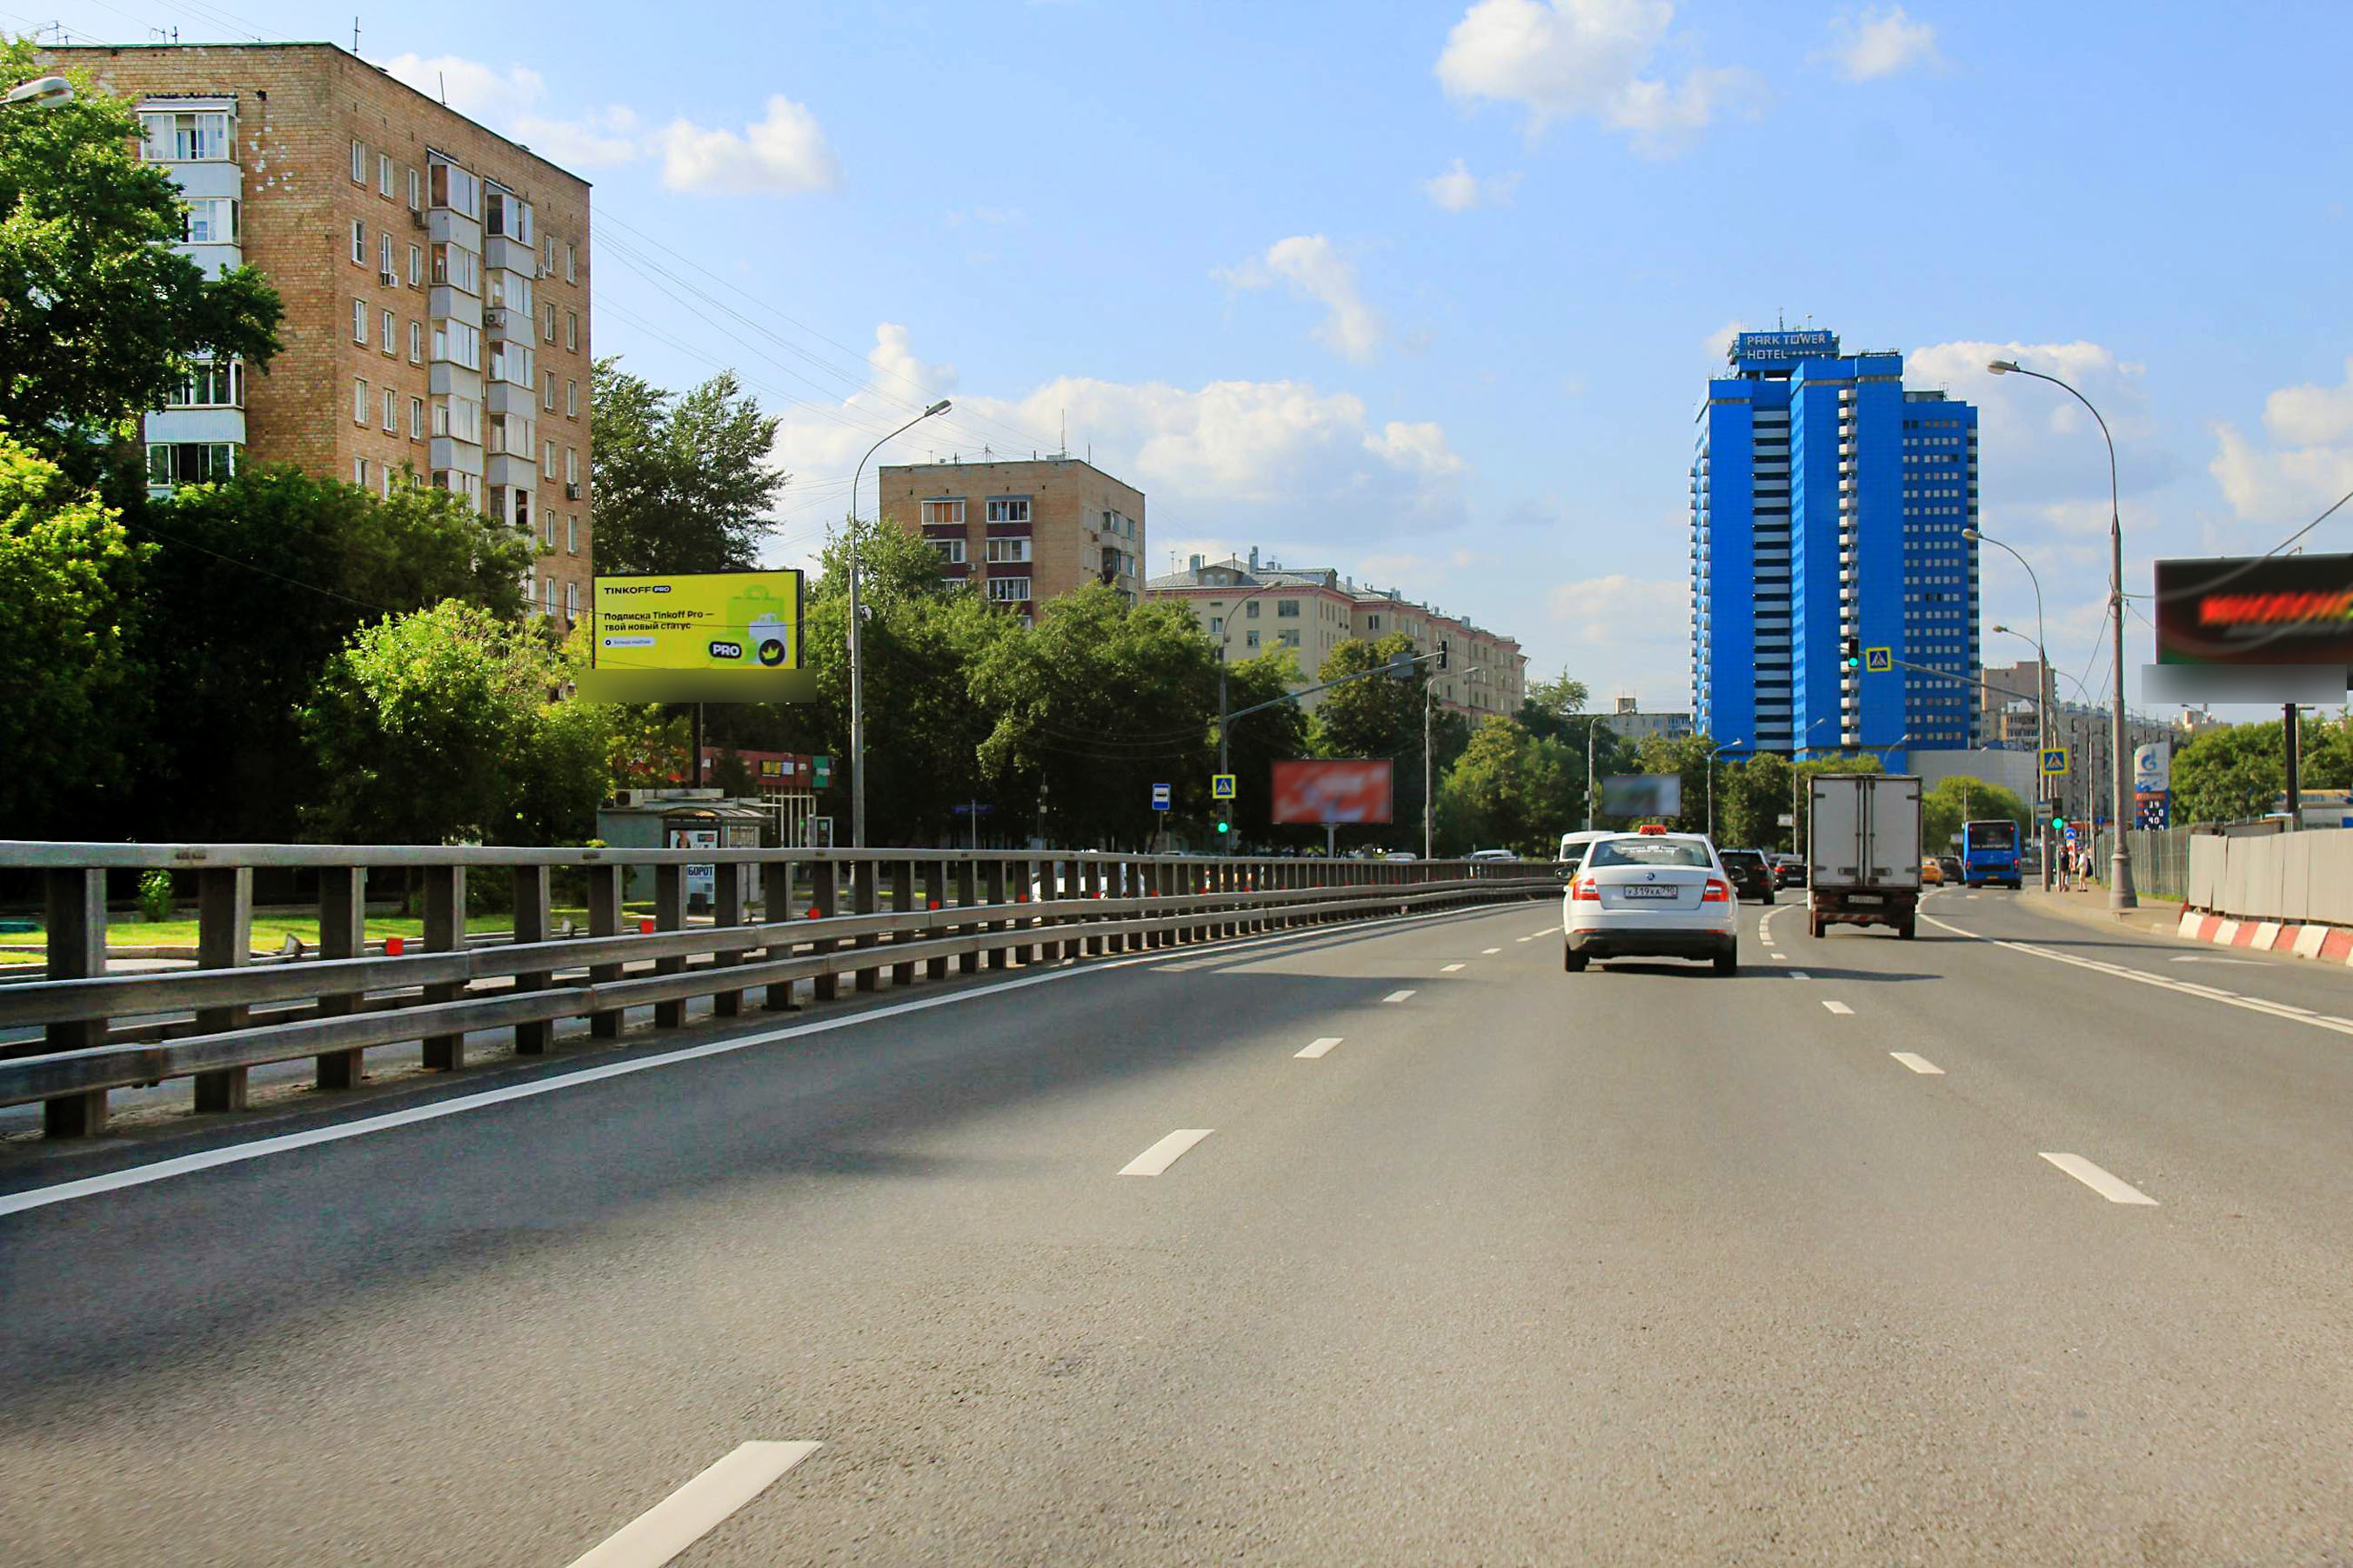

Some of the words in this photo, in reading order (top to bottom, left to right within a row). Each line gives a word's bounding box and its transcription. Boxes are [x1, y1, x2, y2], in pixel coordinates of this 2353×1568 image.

[1747, 335, 1780, 345] PARK
[1783, 333, 1826, 344] TOWER
[1747, 350, 1788, 360] HOTEL
[604, 612, 651, 621] Подписка
[653, 611, 685, 619] Tinkoff
[605, 623, 626, 631] твой
[628, 621, 659, 631] новый
[660, 622, 692, 631] статус
[712, 644, 739, 657] PRO
